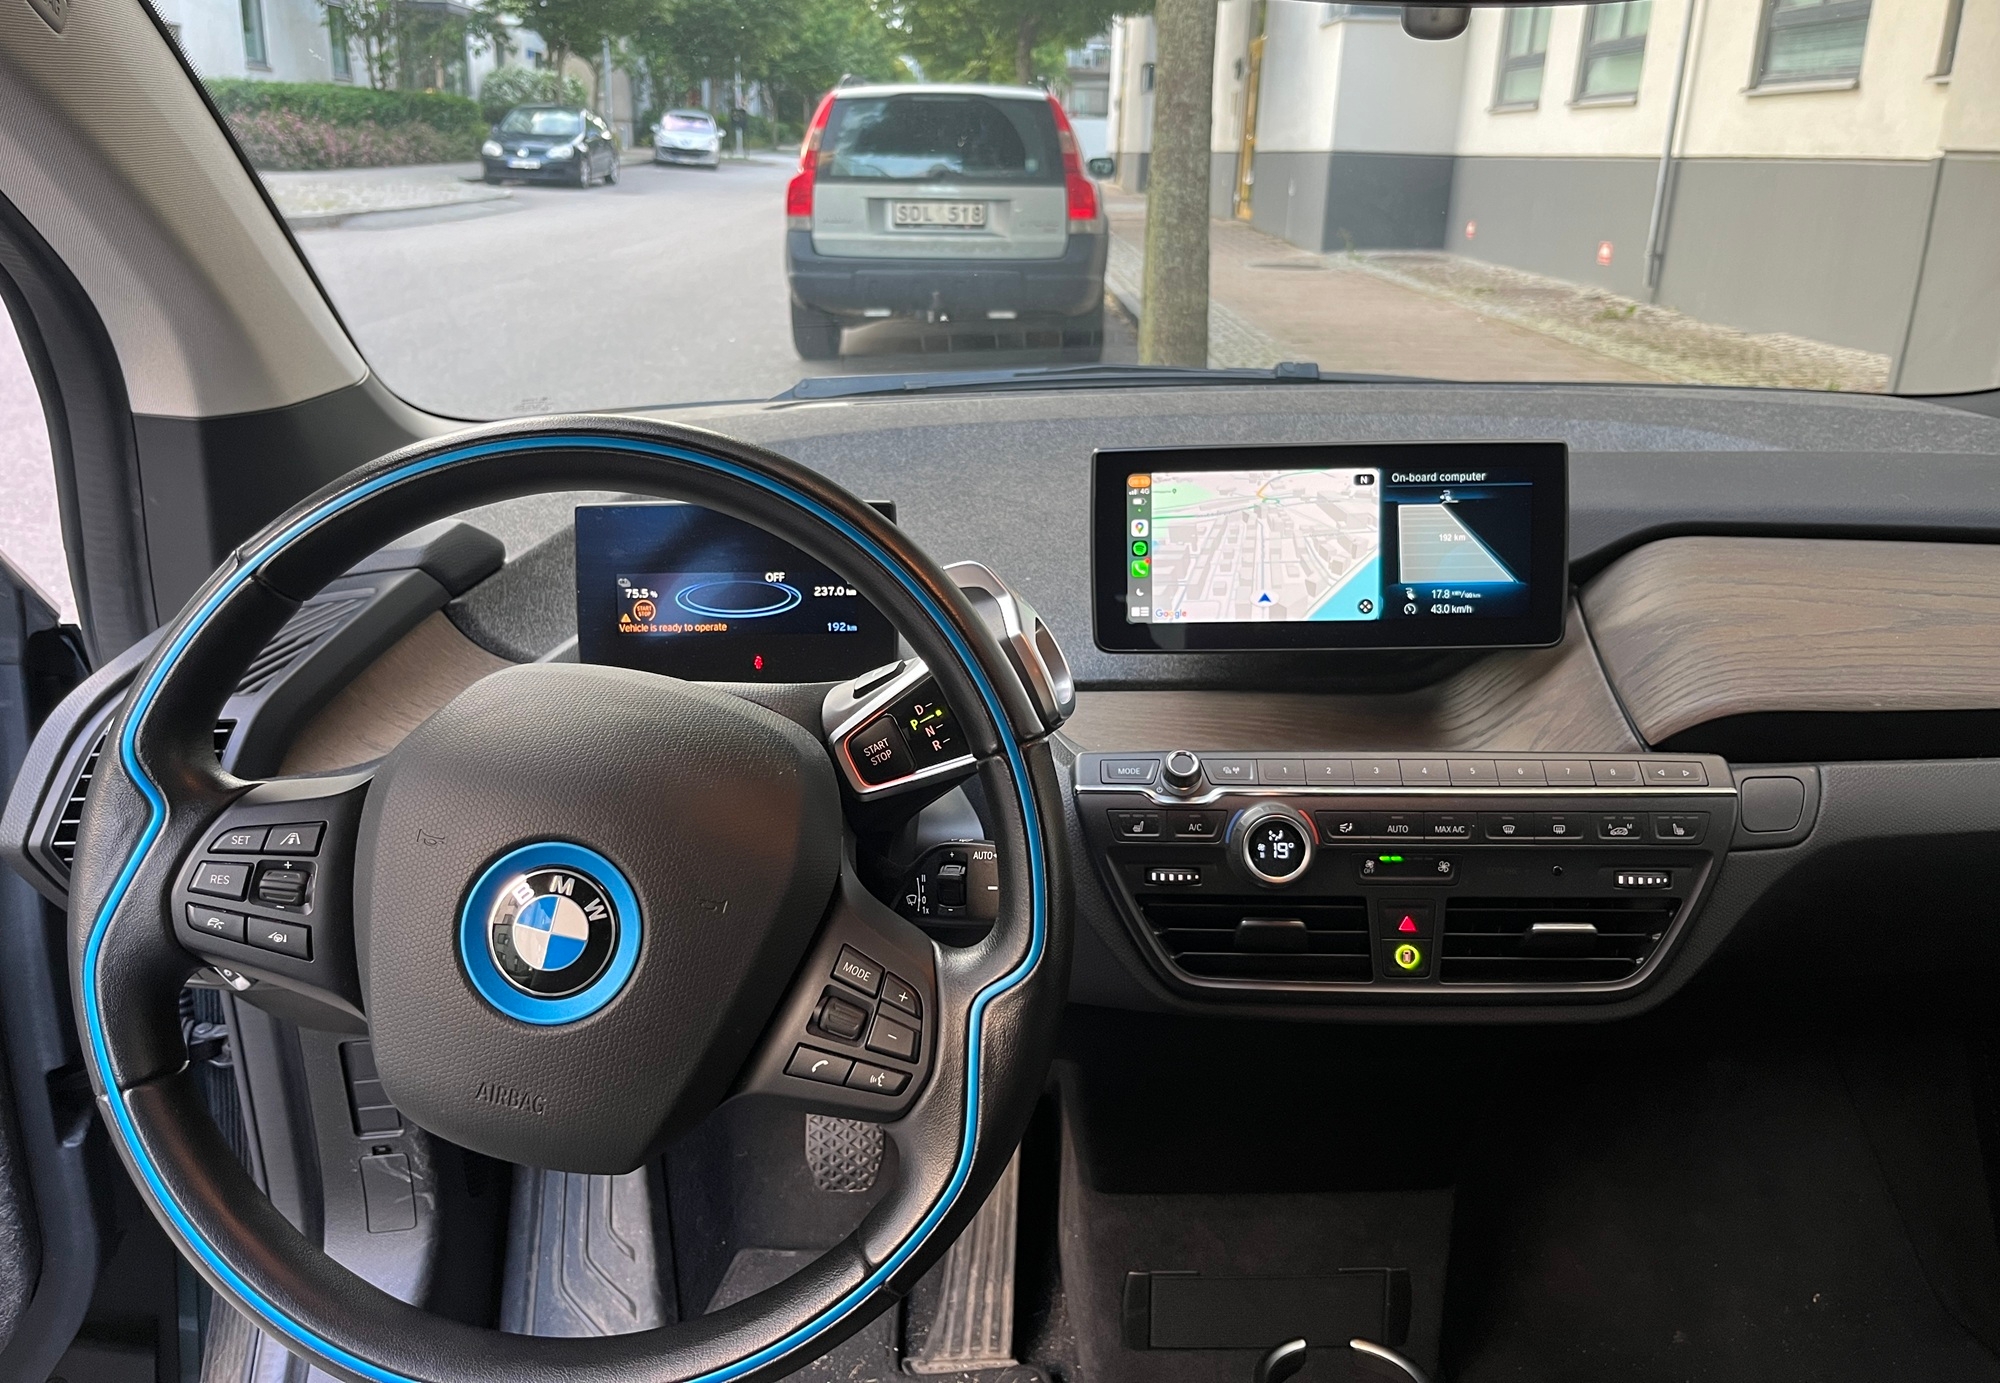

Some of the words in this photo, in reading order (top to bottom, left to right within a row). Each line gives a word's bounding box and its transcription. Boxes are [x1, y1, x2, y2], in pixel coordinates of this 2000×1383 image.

[897, 206, 932, 222] SDL
[948, 206, 984, 223] 518
[1391, 472, 1437, 483] On-board
[1439, 472, 1486, 483] computer
[1439, 533, 1452, 542] 192
[1453, 533, 1466, 542] km
[765, 572, 785, 582] OFF
[625, 588, 649, 599] 75.5
[814, 586, 845, 597] 237.0
[1431, 589, 1450, 599] 17.8
[1155, 608, 1187, 619] Google
[1430, 604, 1450, 614] 43.0
[1451, 604, 1473, 614] km/h
[619, 623, 649, 633] Vehicle
[650, 623, 658, 632] is
[659, 623, 683, 634] ready
[684, 623, 693, 632] to
[694, 623, 728, 633] operate
[827, 622, 846, 632] 192
[914, 704, 924, 716] D
[910, 719, 918, 731] P
[925, 725, 936, 738] N
[863, 737, 890, 757] START
[932, 739, 942, 752] R
[870, 749, 892, 766] STOP
[1117, 767, 1141, 775] MODE
[1188, 823, 1202, 832] A/C
[1387, 825, 1409, 833] AUTO
[1434, 825, 1451, 833] MAX
[1452, 825, 1465, 834] A/C
[231, 835, 251, 845] SET
[973, 851, 993, 860] AUTO
[209, 874, 231, 885] RES
[512, 875, 608, 921] BMW
[842, 961, 872, 982] MODE
[474, 1081, 546, 1116] AIRBAG
